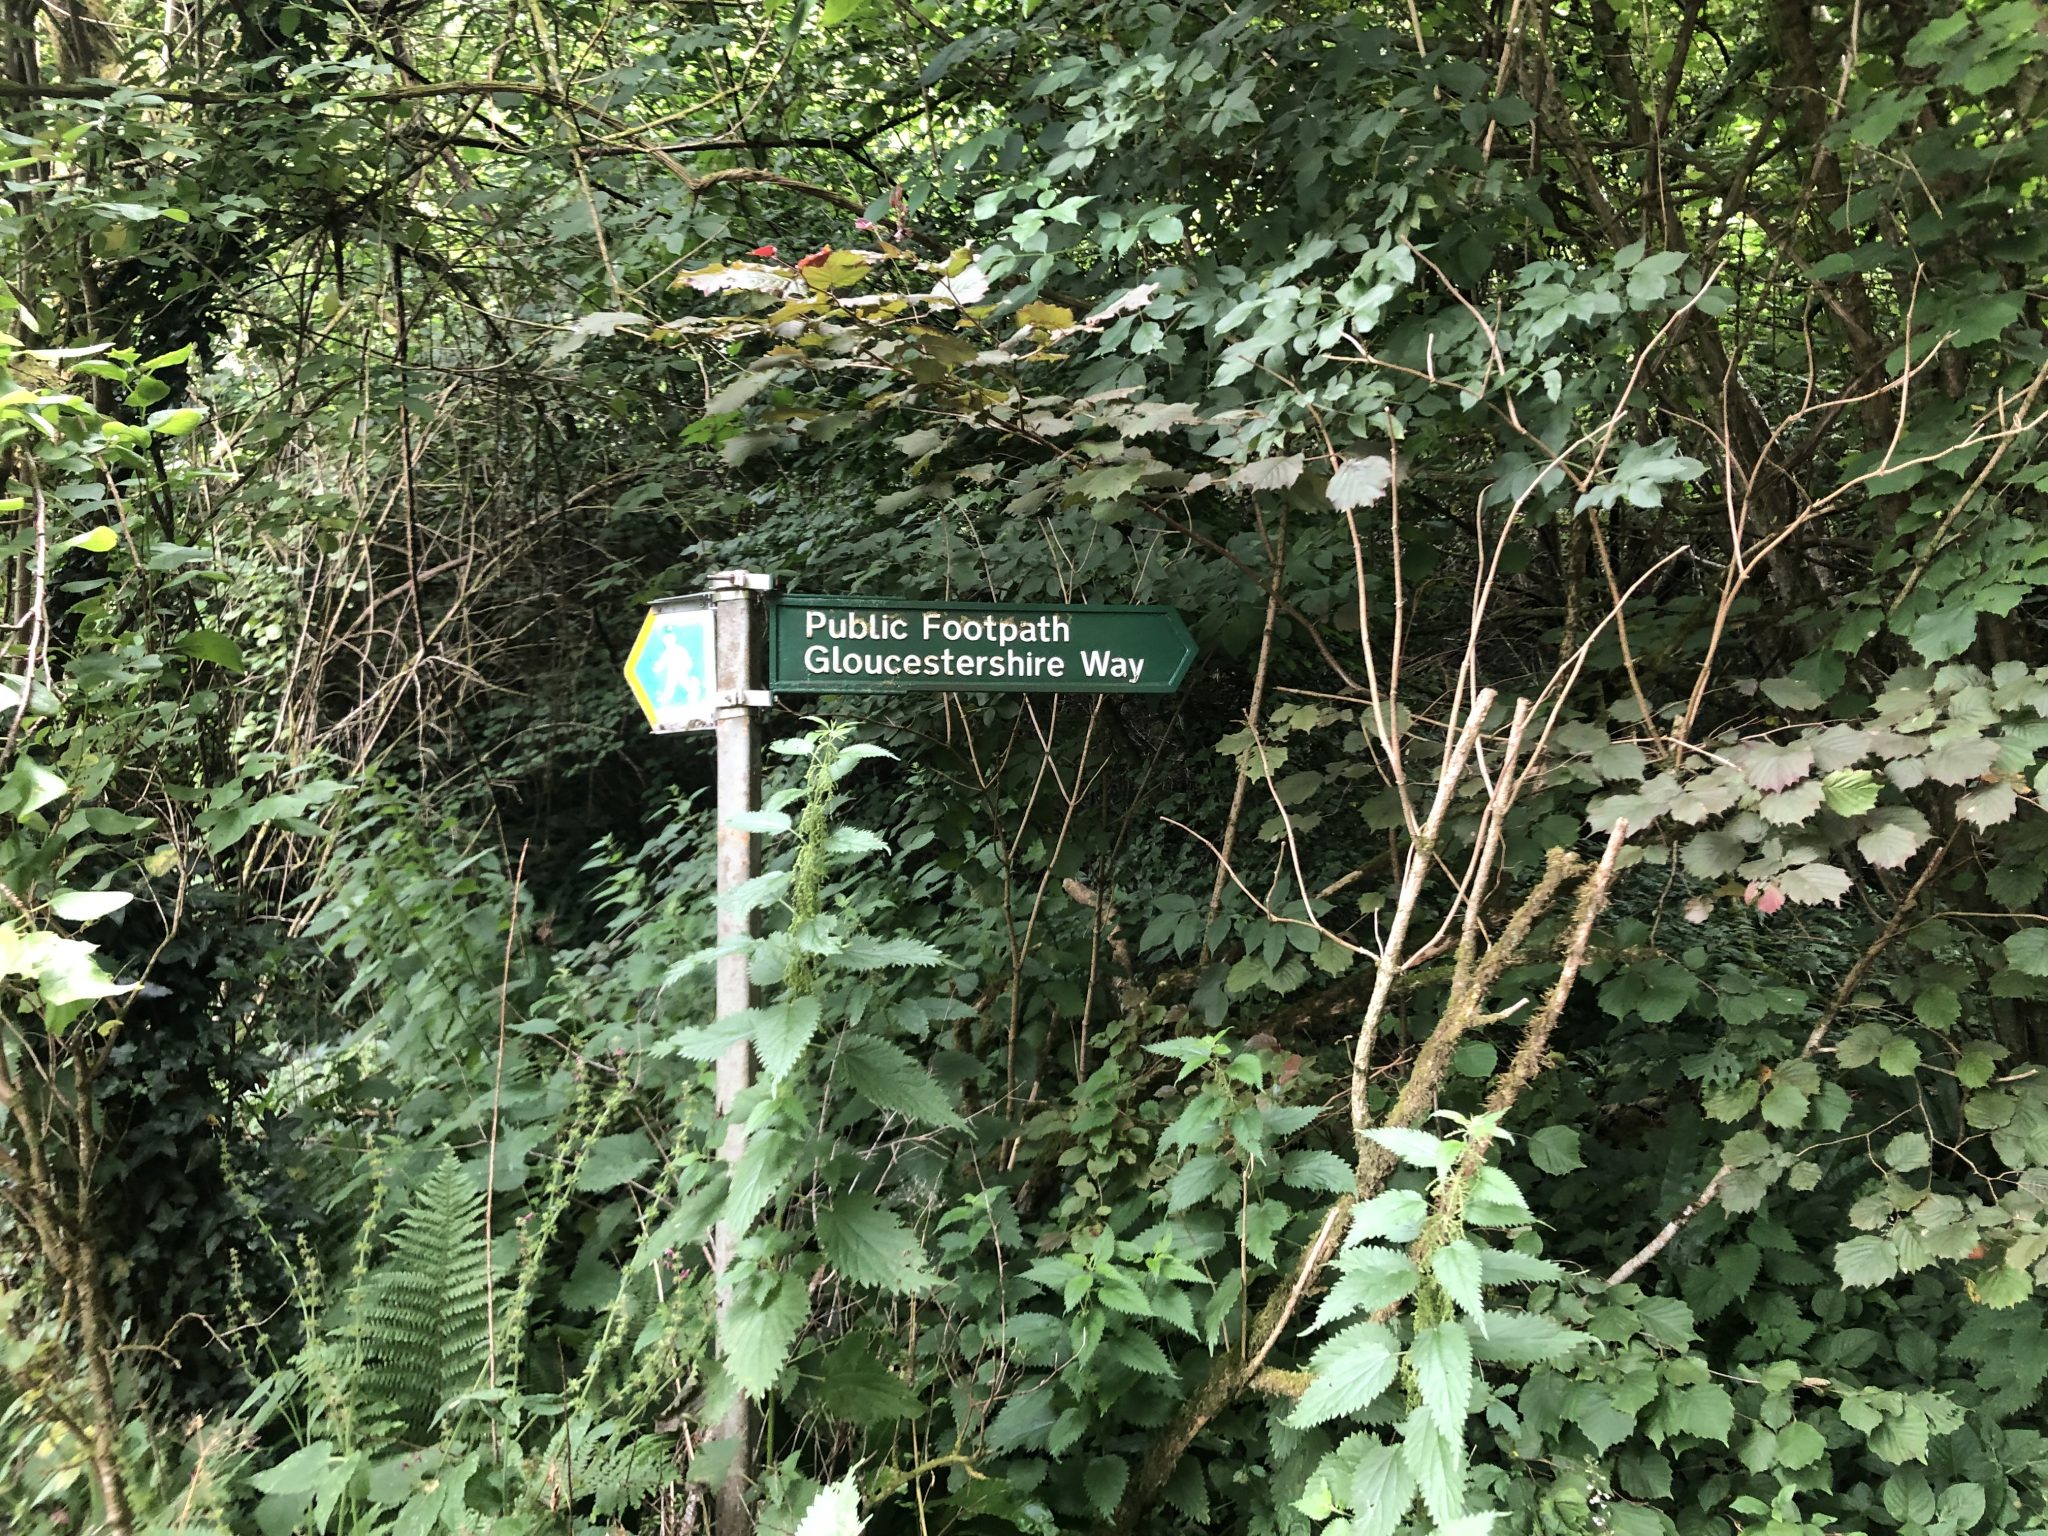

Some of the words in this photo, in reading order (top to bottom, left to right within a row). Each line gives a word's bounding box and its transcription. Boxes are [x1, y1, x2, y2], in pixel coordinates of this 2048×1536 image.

[805, 610, 908, 639] Public
[922, 613, 1070, 647] Footpath
[803, 644, 1065, 678] Gloucestershire
[1080, 650, 1145, 684] Way
